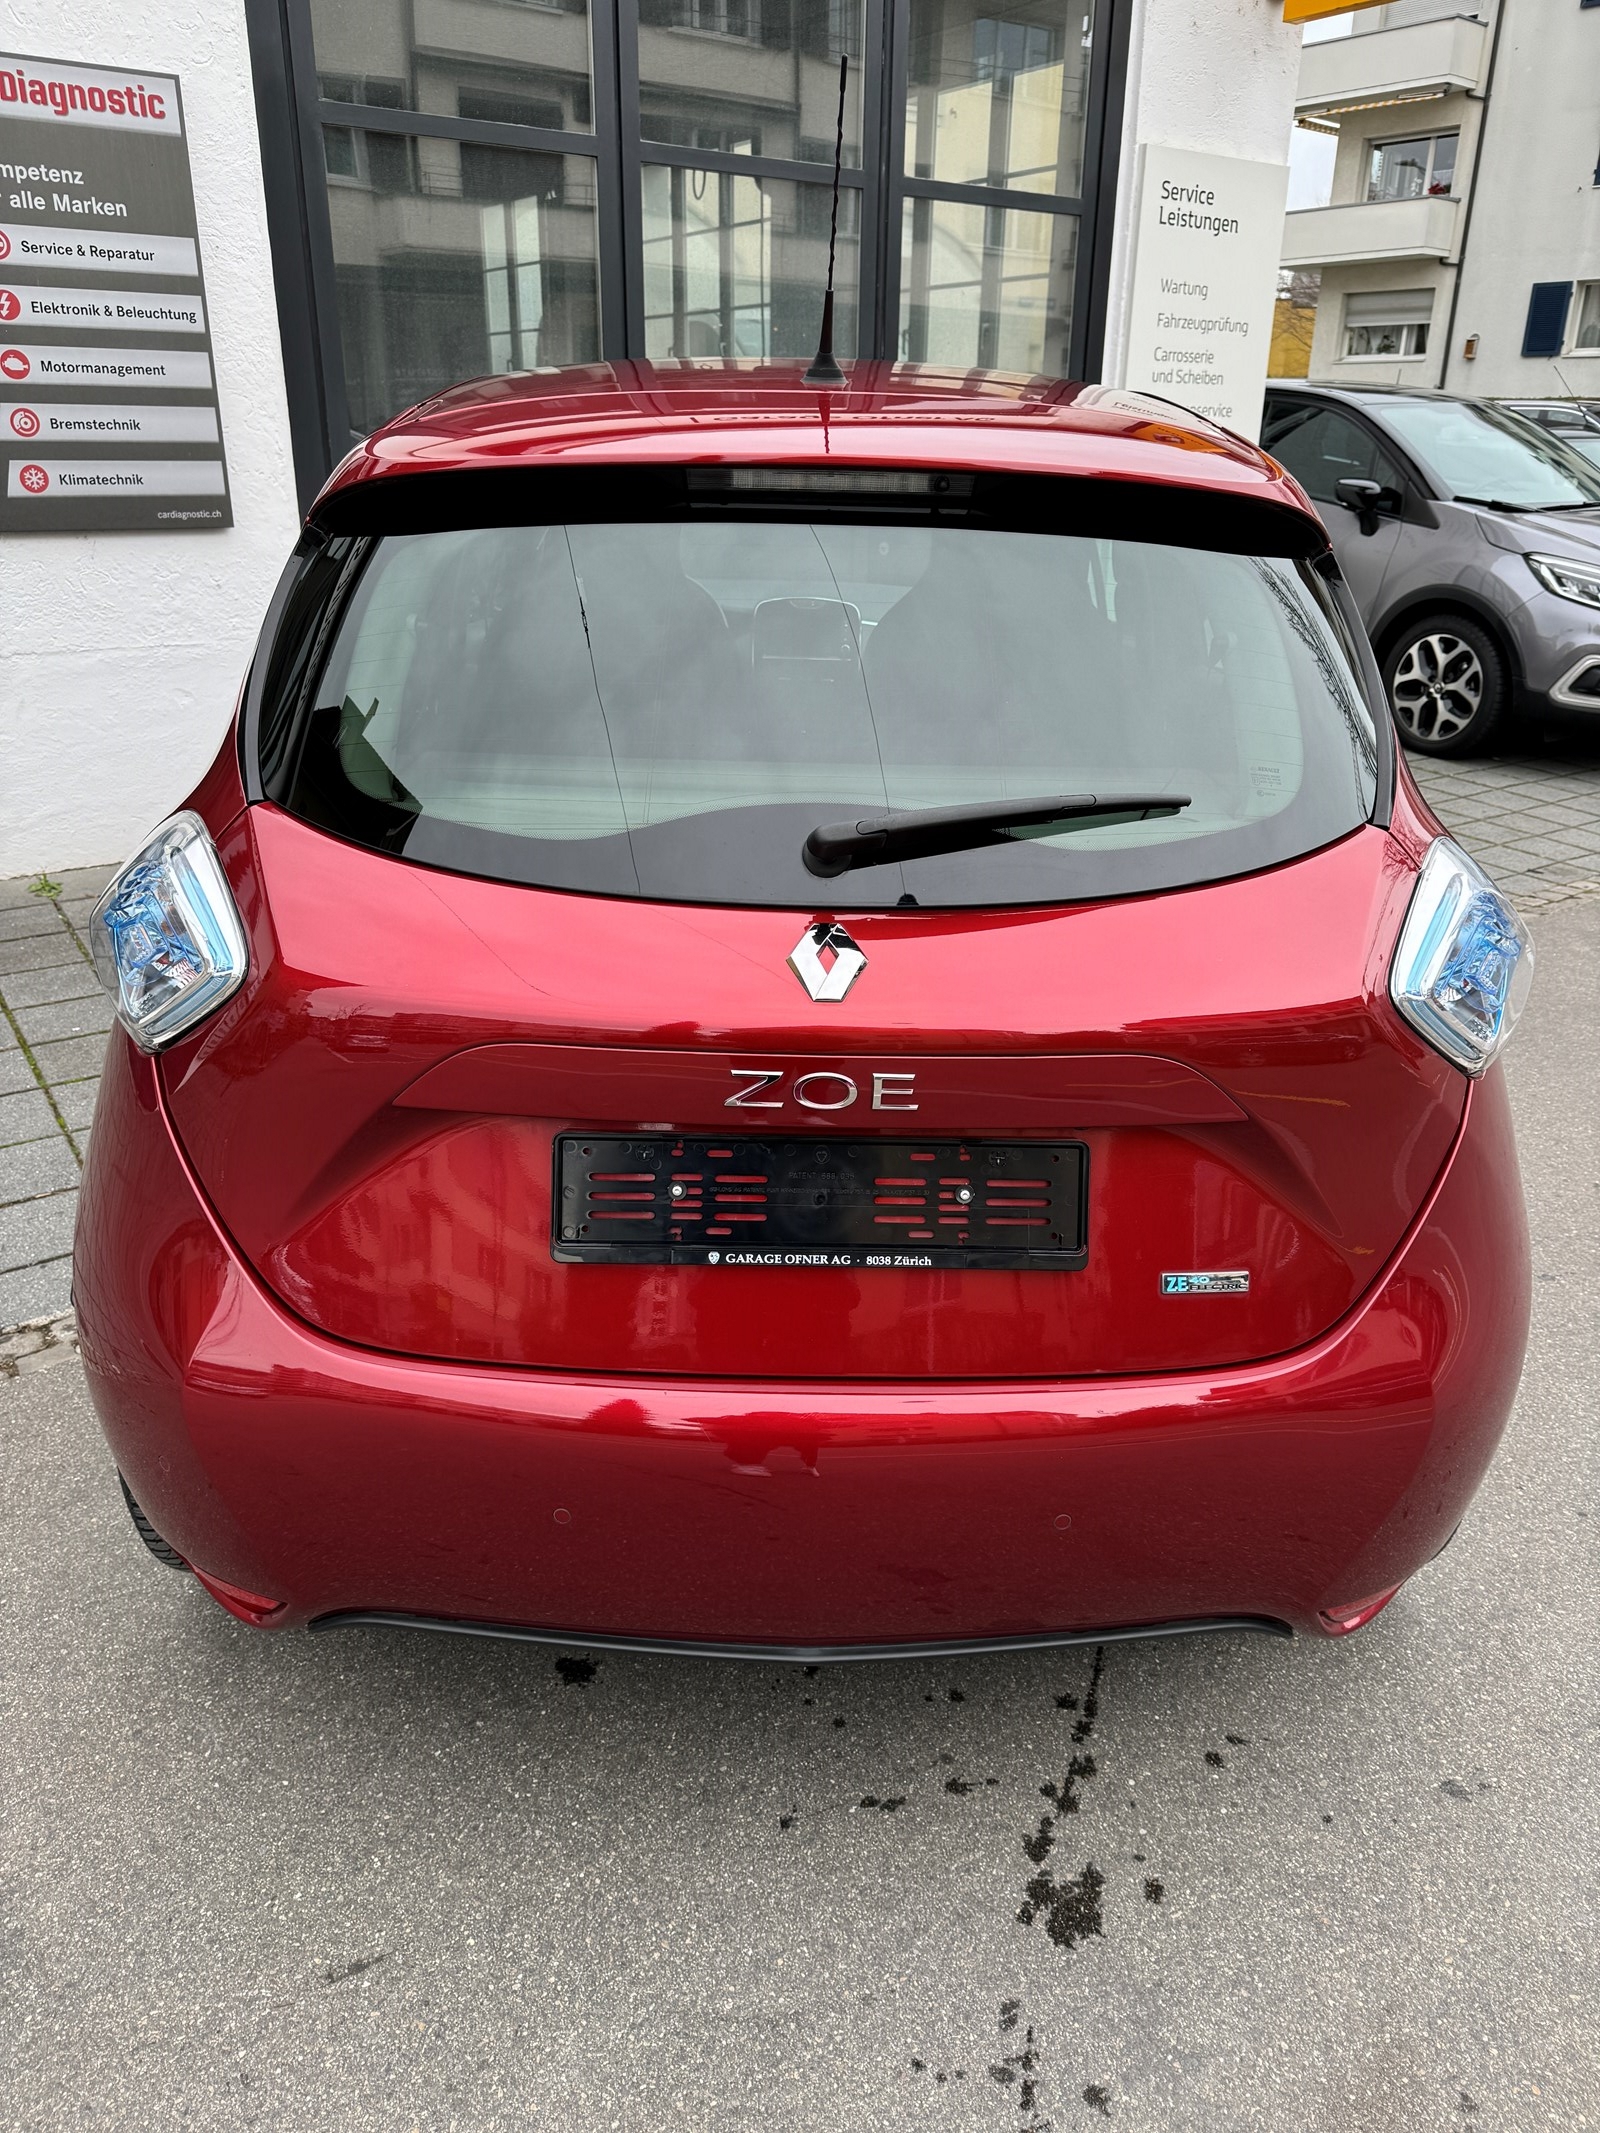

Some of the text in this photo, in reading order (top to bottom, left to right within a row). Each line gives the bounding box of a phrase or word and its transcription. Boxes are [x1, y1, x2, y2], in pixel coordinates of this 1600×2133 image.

[1161, 180, 1215, 205] Service
[9, 190, 128, 217] alle Marken
[1159, 205, 1239, 237] Leistungen
[21, 240, 155, 261] Service & Reparatur
[1160, 278, 1209, 300] Wartung
[31, 301, 197, 323] Elektronik & Beleuchtung
[1157, 312, 1249, 337] Fahrzeugprüfung
[1154, 346, 1214, 364] Carrosserie
[40, 360, 166, 377] Motormanagement
[1152, 369, 1224, 385] und Scheiben
[50, 417, 141, 431] Bremstechnik
[59, 473, 144, 486] Klimatechnik
[157, 509, 222, 520] cardiagnostic.ch
[724, 1069, 919, 1111] ZOE
[725, 1253, 932, 1266] GARAGE OFNER AG 8038 Zürich
